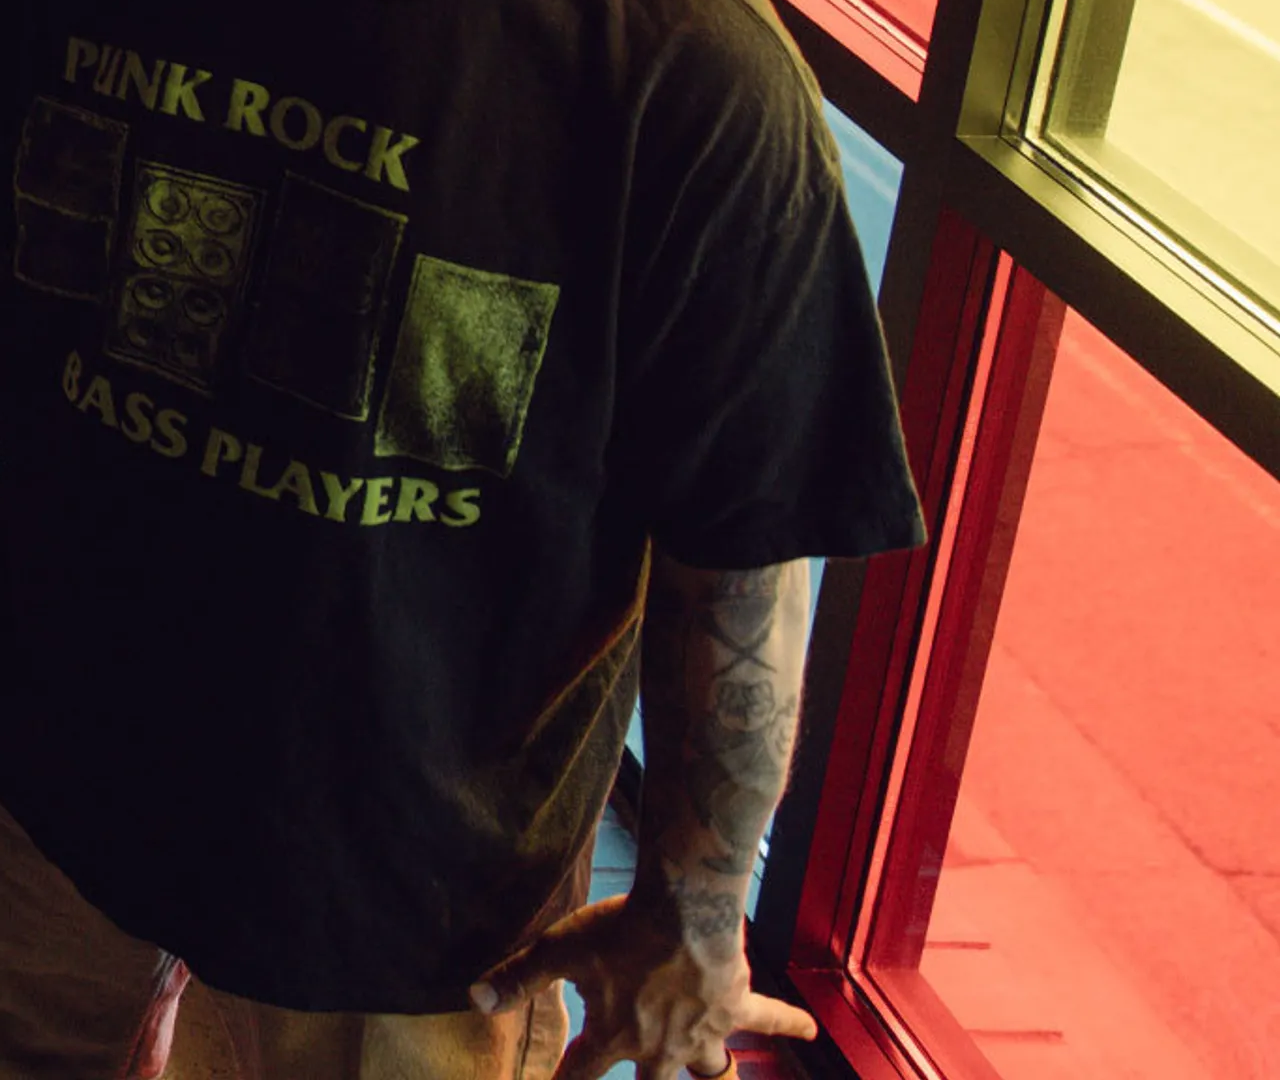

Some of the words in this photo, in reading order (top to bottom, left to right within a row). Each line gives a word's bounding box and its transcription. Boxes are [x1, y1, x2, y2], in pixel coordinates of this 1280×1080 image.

[65, 36, 213, 122] PUNK
[224, 77, 420, 192] ROCK
[61, 349, 188, 458] BASS
[200, 426, 482, 528] PLAYERS
